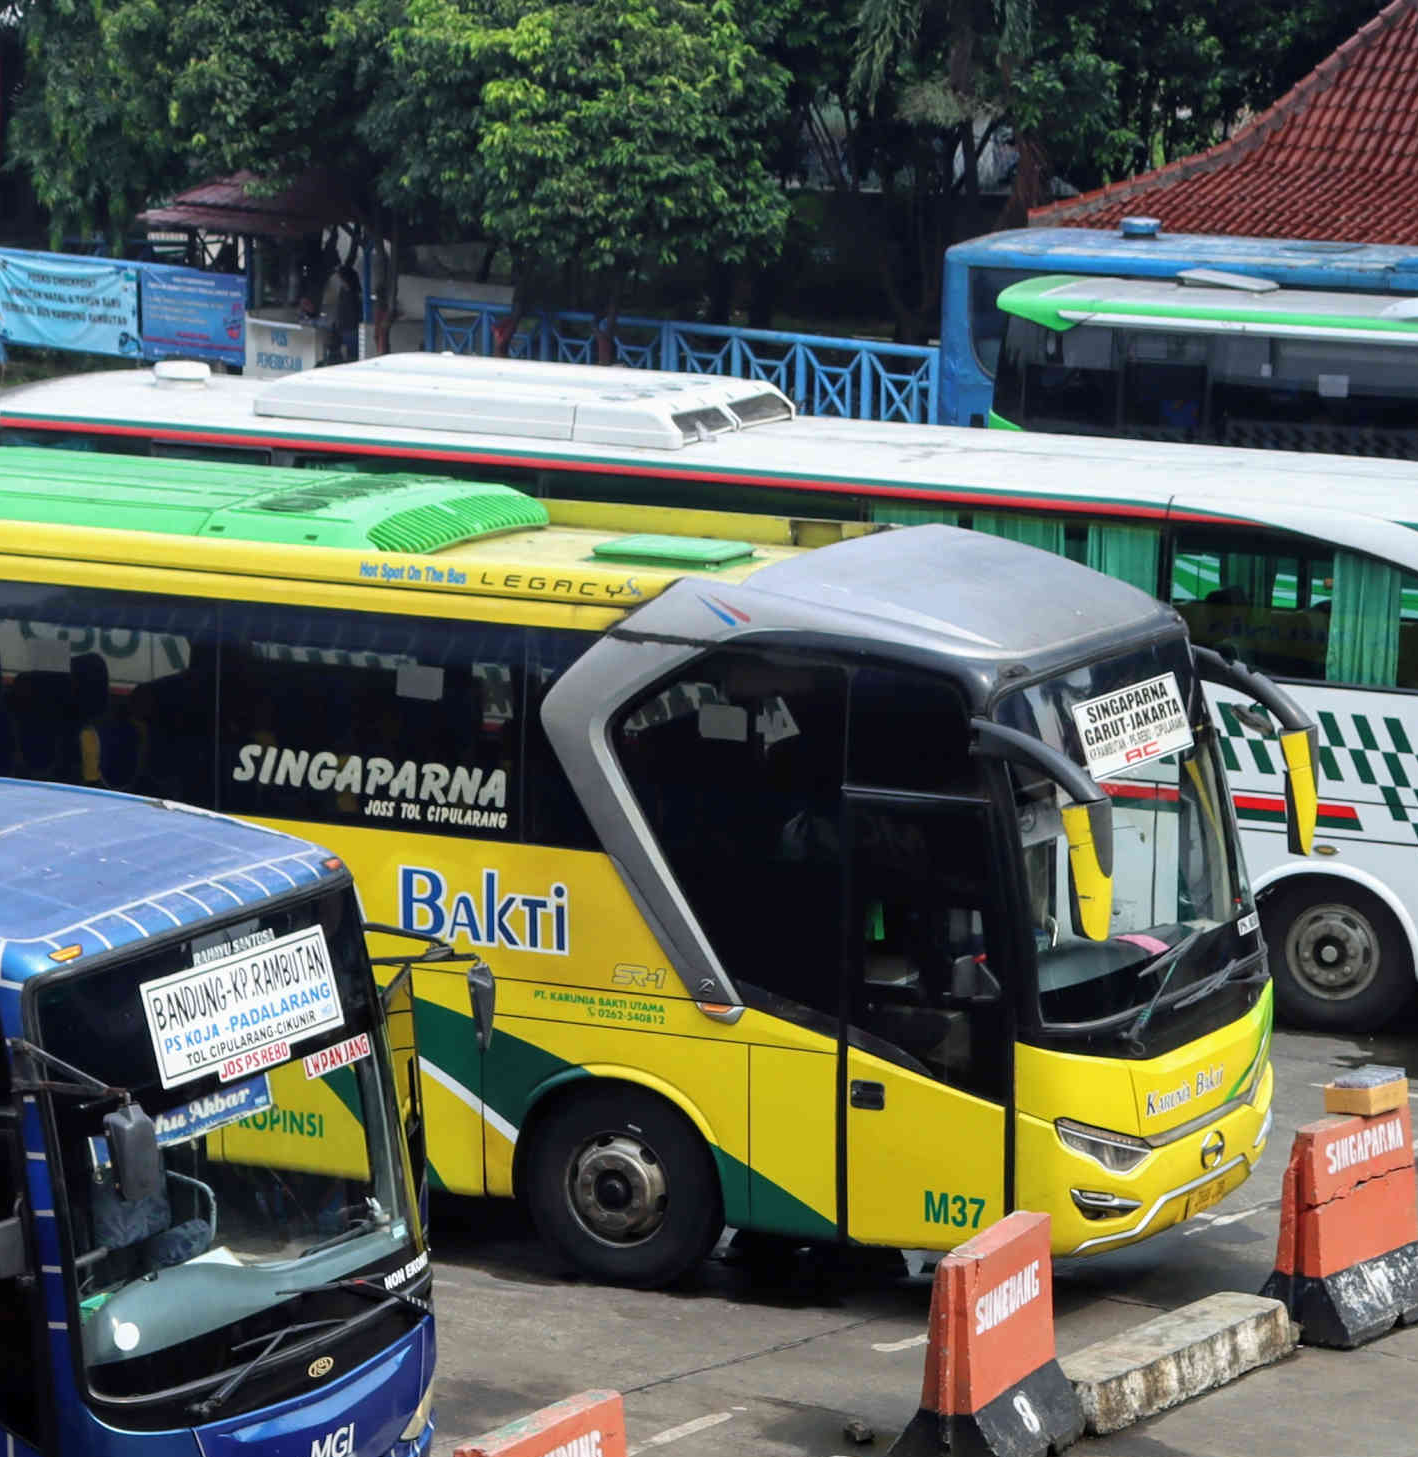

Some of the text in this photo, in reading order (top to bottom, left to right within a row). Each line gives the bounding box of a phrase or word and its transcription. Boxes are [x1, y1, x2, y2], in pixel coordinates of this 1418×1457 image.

[480, 572, 624, 597] LEGACY
[1087, 681, 1168, 723] SINGAPARNA
[1085, 698, 1181, 746] GARUT-JAKARTA
[1125, 741, 1161, 763] AC
[233, 744, 508, 809] SINGAPARNA
[364, 799, 508, 829] JOSS TOL CIPULARANG
[550, 990, 597, 1007] KARUNIA
[598, 994, 629, 1009] BAKTI
[630, 997, 665, 1014] UTAMA
[184, 1023, 221, 1049] KOJA
[186, 1048, 208, 1066] TOL
[924, 1190, 985, 1230] M37
[384, 1267, 407, 1291] NON
